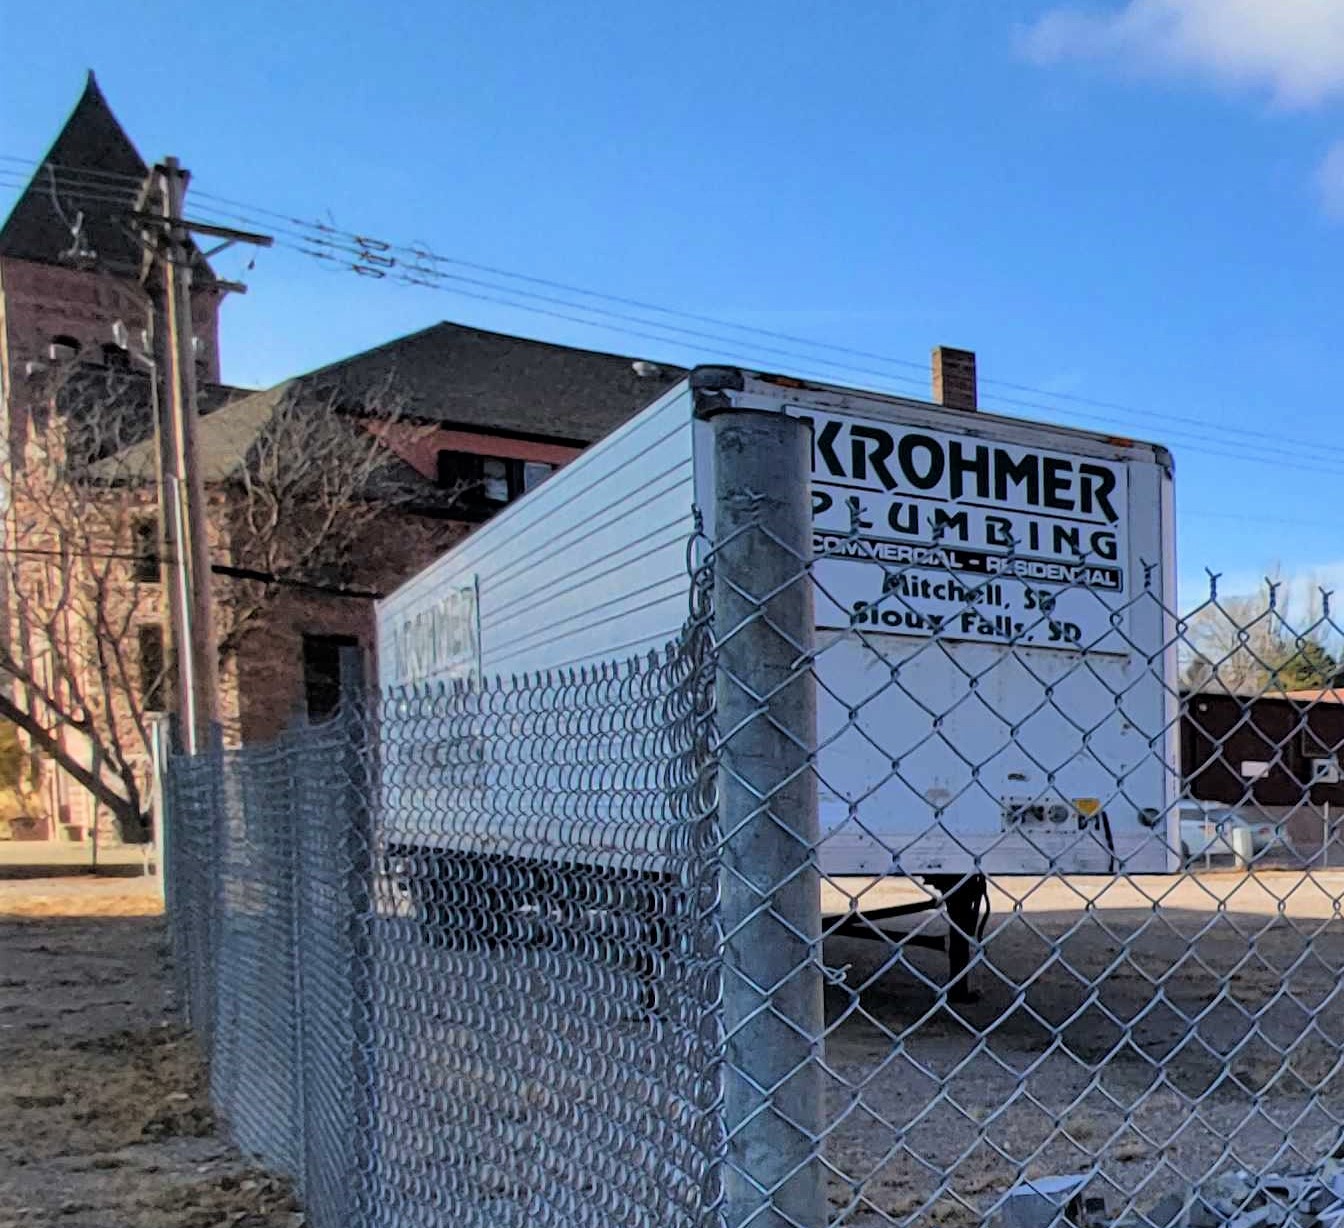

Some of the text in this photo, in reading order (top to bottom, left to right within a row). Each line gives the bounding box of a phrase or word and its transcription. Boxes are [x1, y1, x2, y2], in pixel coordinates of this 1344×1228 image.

[811, 420, 1119, 523] KROHMER
[811, 490, 1117, 560] PLUMBING
[813, 534, 963, 568] COMMERCIAL
[882, 571, 1056, 612] Mitchell, SD
[852, 601, 1082, 643] Sioux Falls, SD
